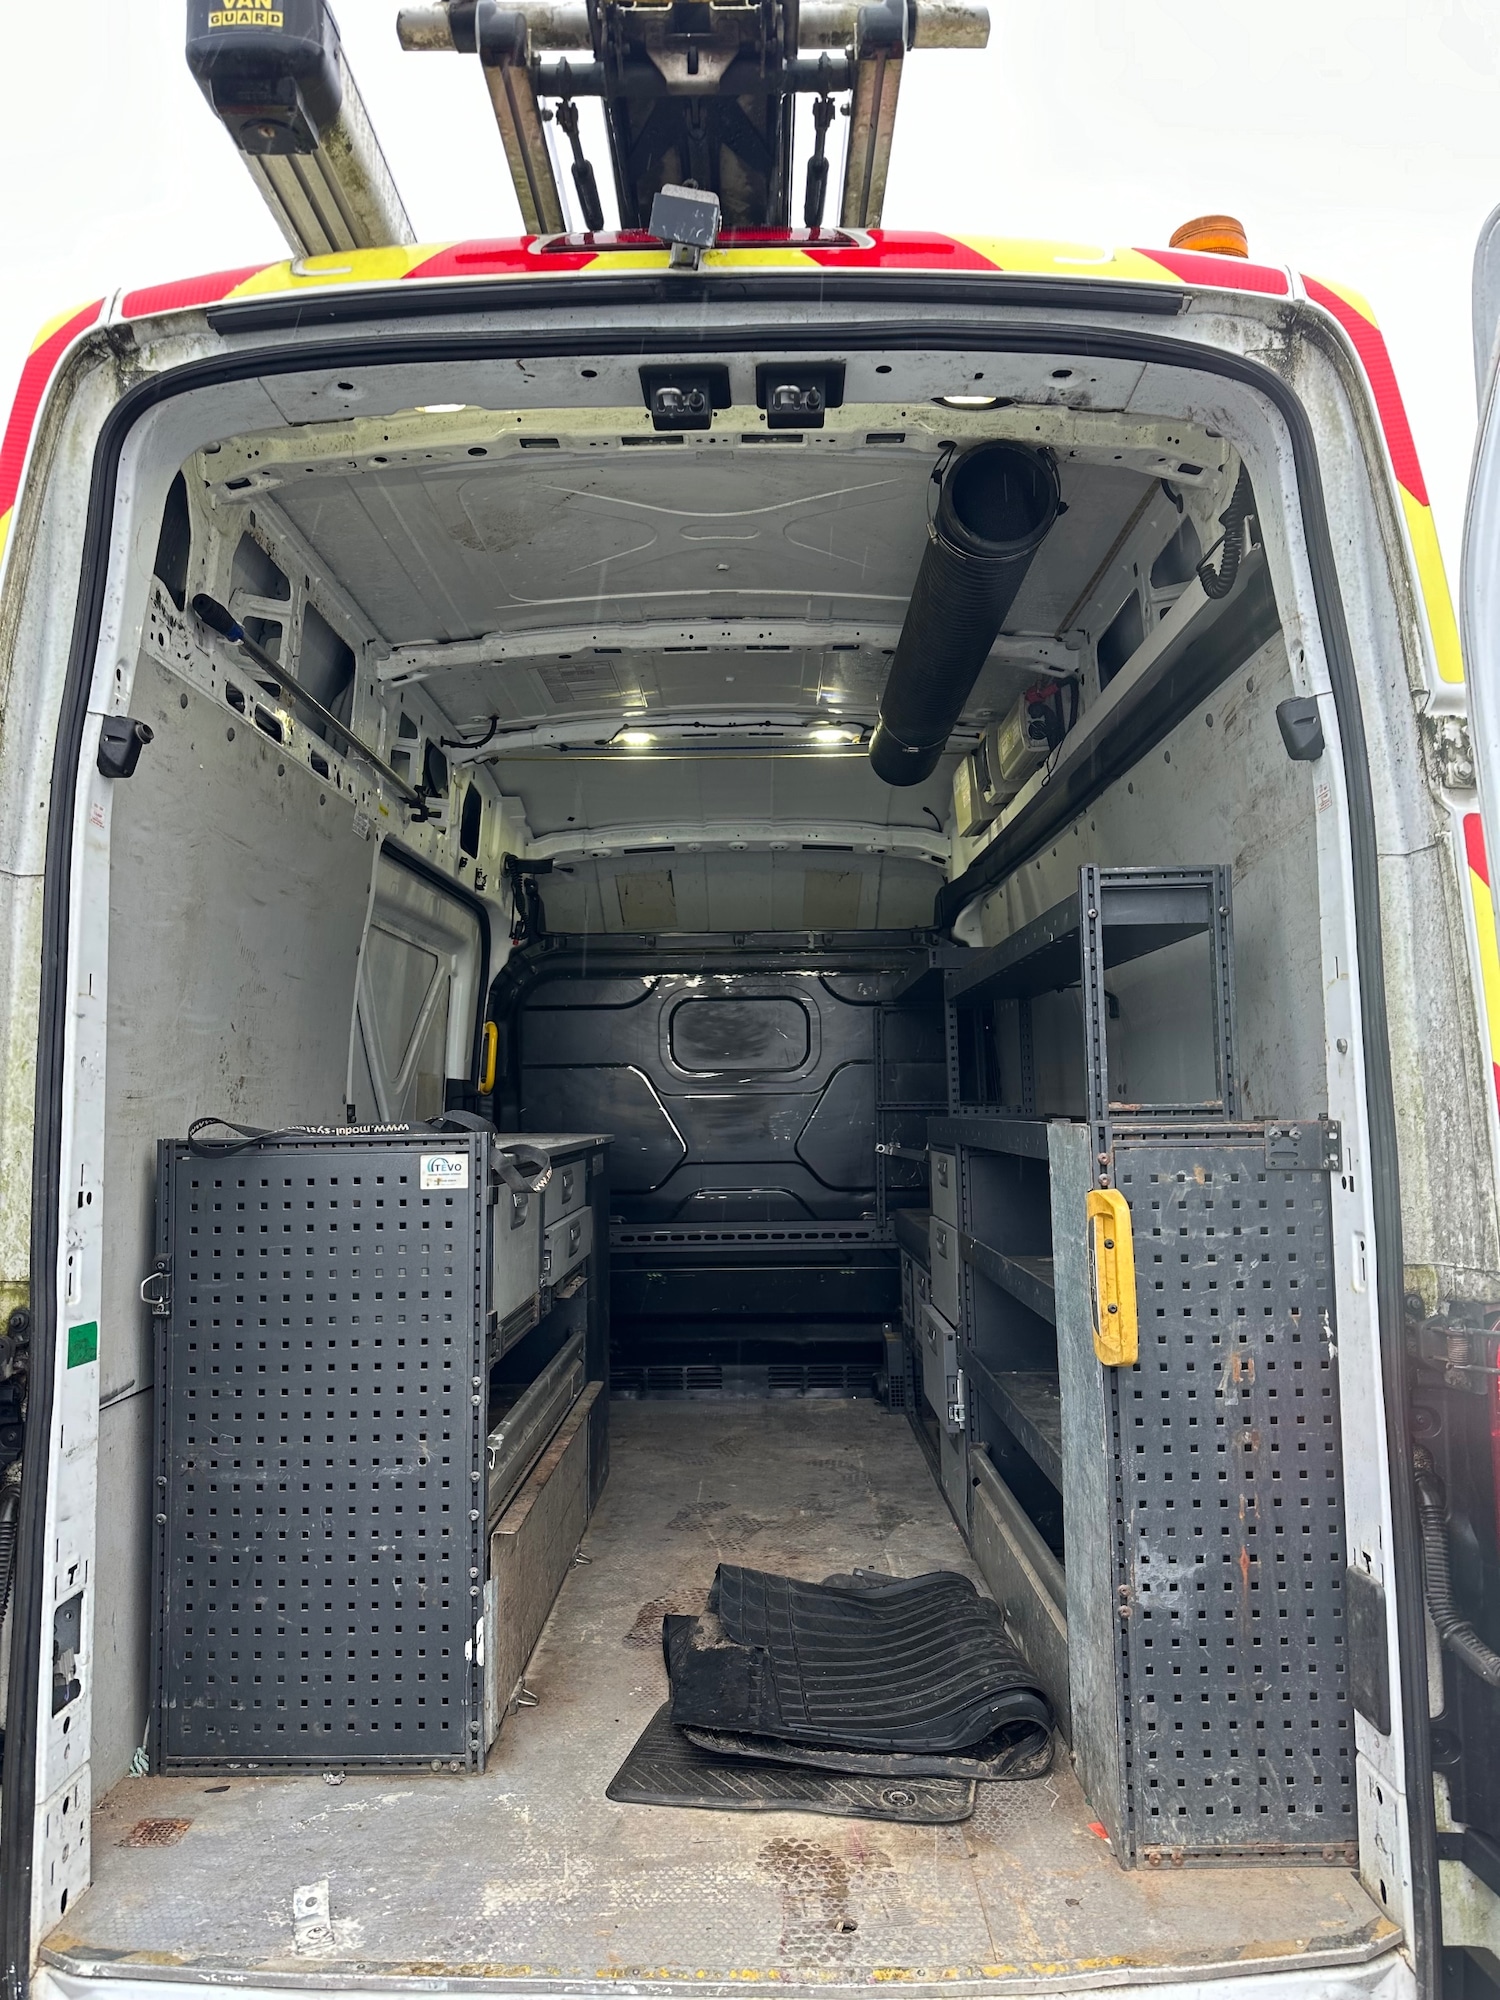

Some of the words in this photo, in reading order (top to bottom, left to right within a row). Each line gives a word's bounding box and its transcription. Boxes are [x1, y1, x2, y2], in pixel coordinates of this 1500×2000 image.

[223, 0, 272, 9] VAN
[211, 12, 280, 24] GUARD
[434, 1163, 462, 1172] TEVO
